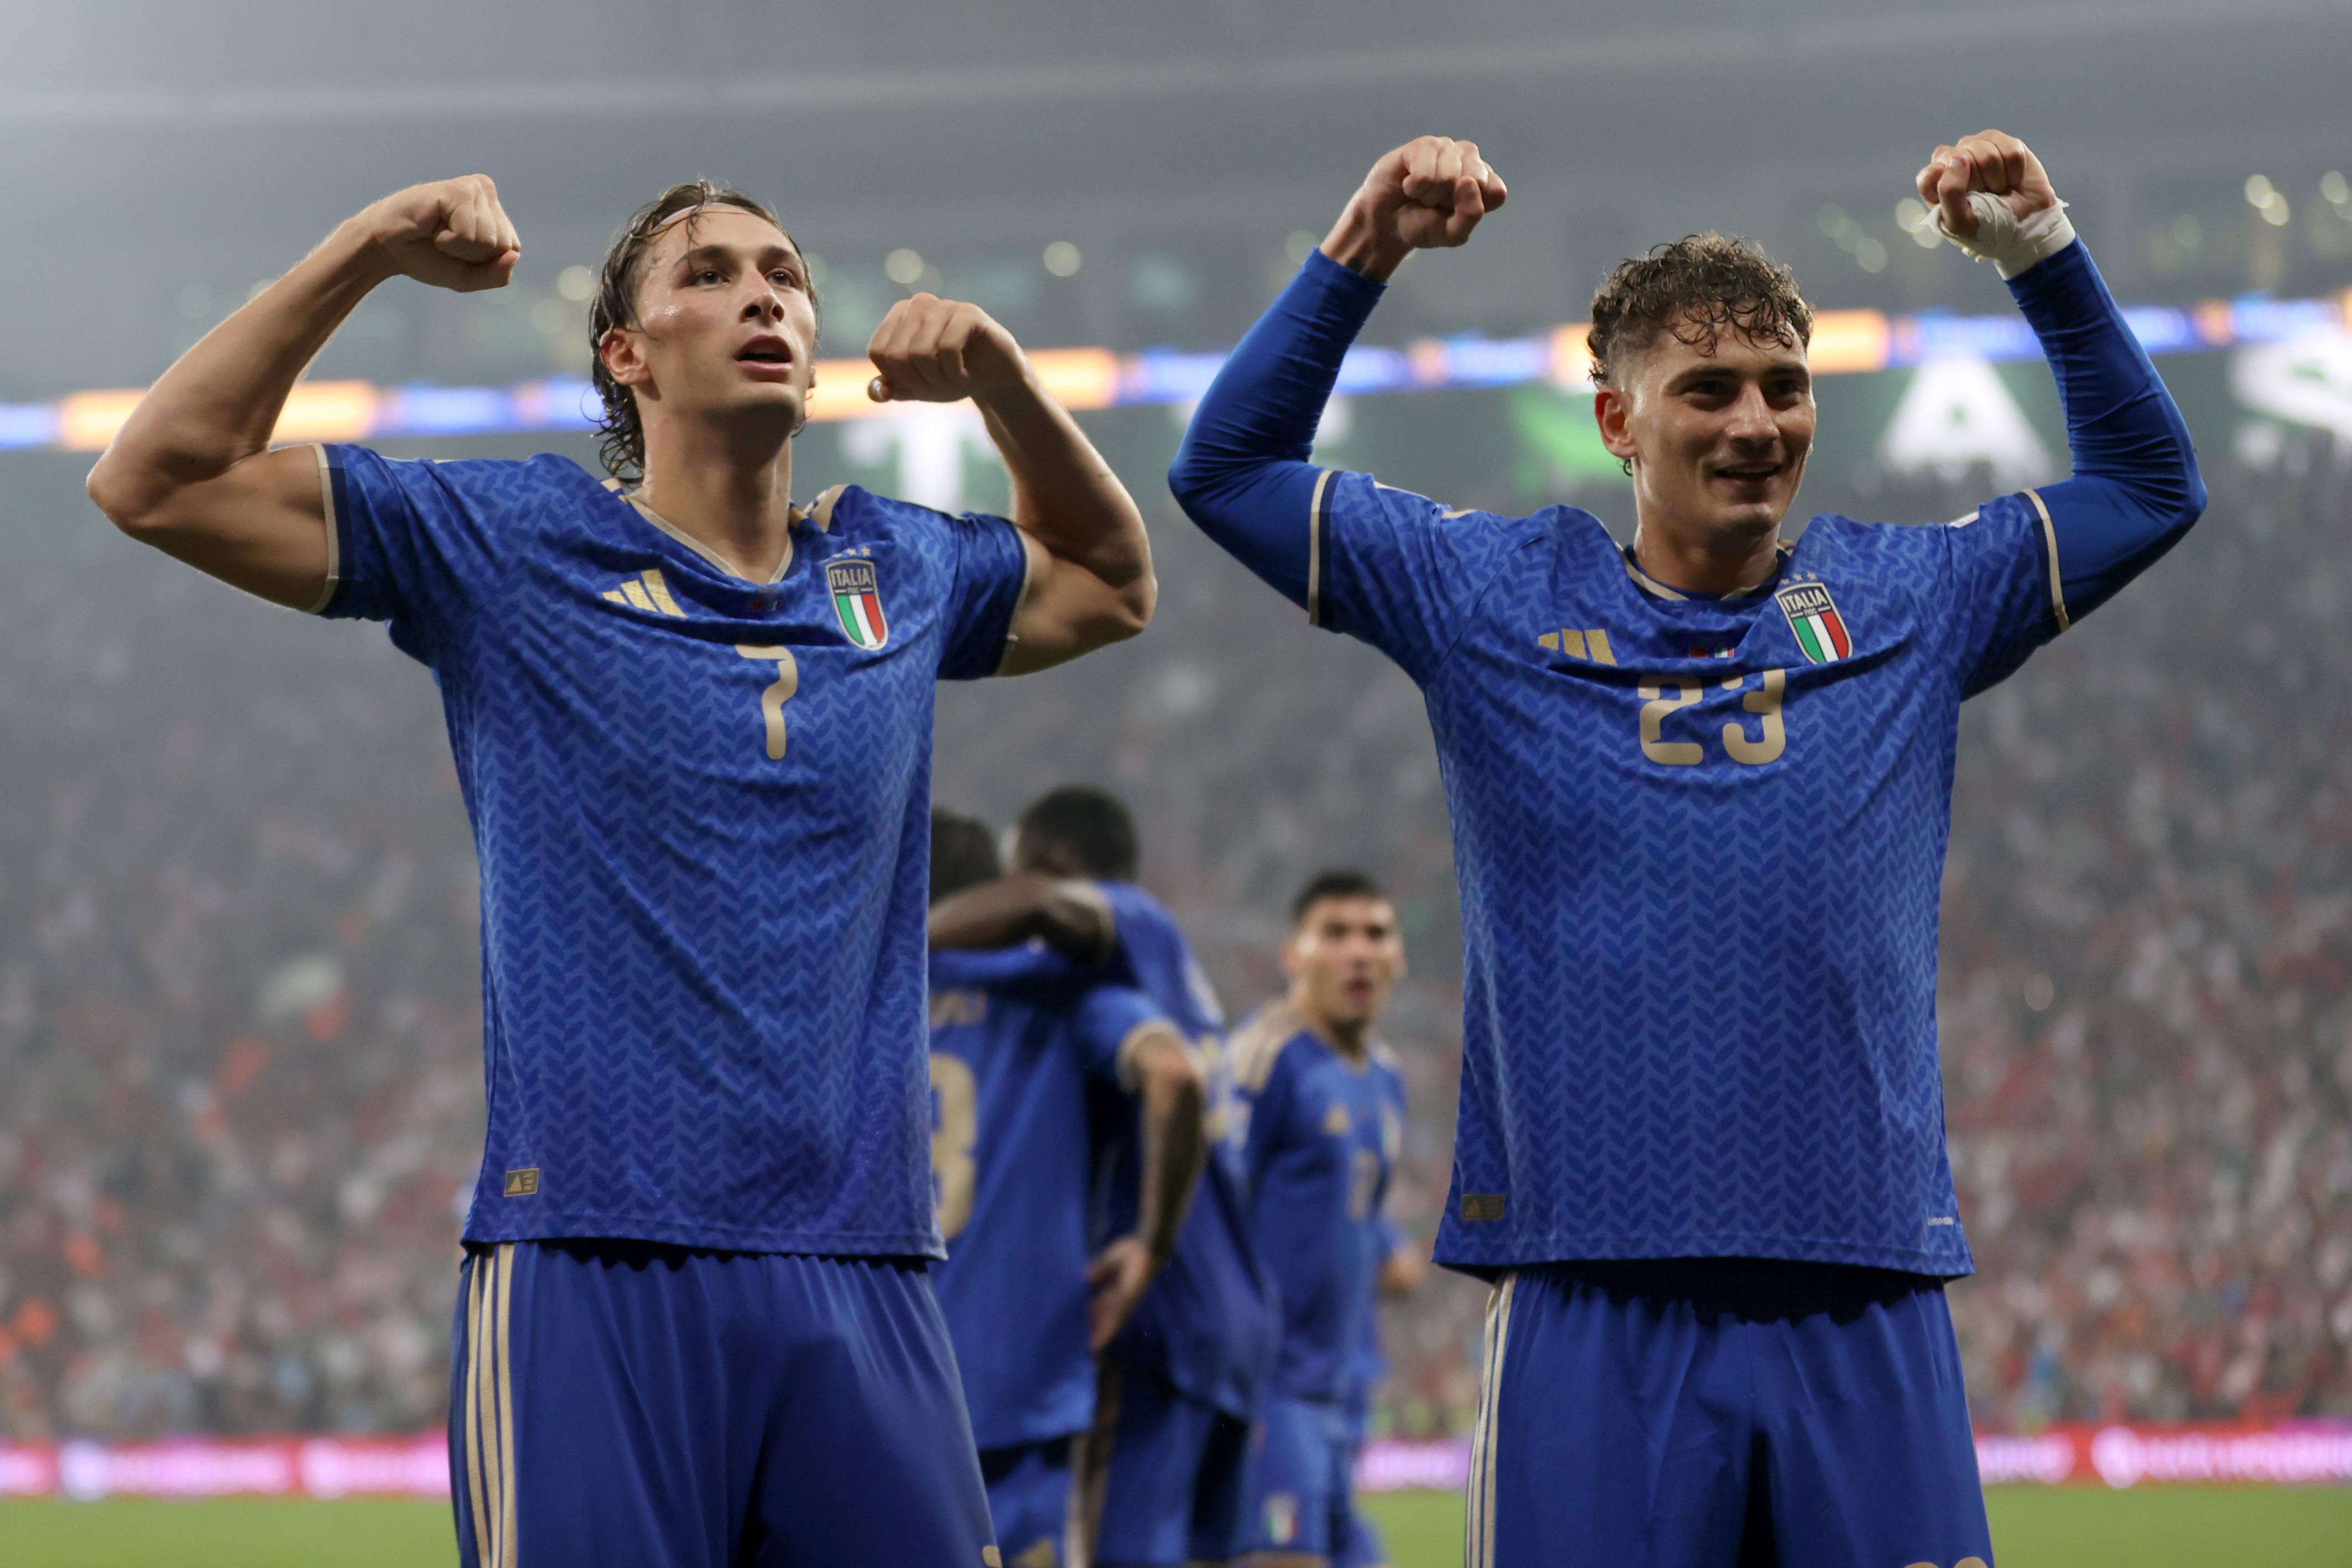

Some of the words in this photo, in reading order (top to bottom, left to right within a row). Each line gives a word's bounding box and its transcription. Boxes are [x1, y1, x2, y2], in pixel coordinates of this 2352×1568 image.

[830, 567, 872, 587] ITALIA
[1781, 588, 1828, 612] ITALIA
[735, 644, 798, 760] 7
[1637, 669, 1786, 765] 23
